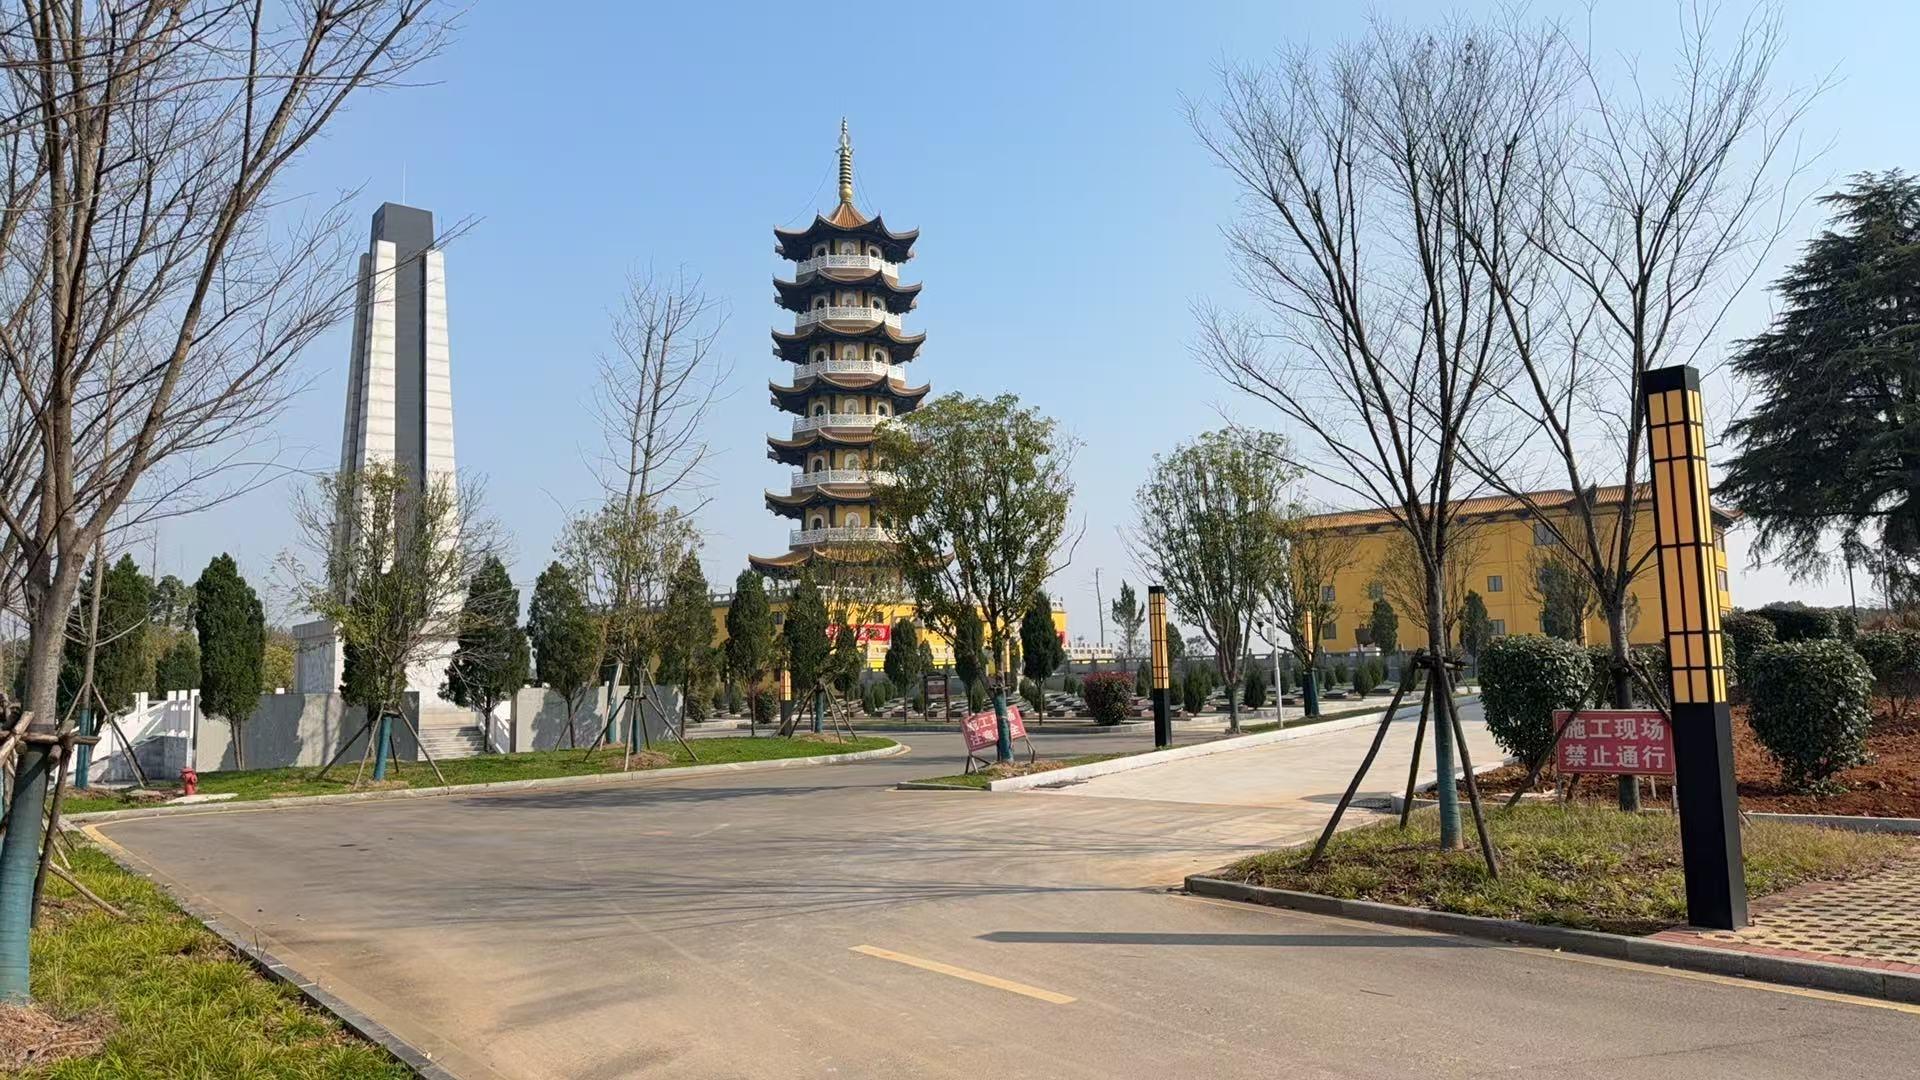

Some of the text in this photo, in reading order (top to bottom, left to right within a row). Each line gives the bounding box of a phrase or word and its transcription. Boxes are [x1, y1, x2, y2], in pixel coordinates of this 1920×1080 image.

[970, 723, 1020, 746] 注意全
[1564, 718, 1664, 740] 施工现场
[1564, 744, 1666, 769] 禁止通行
